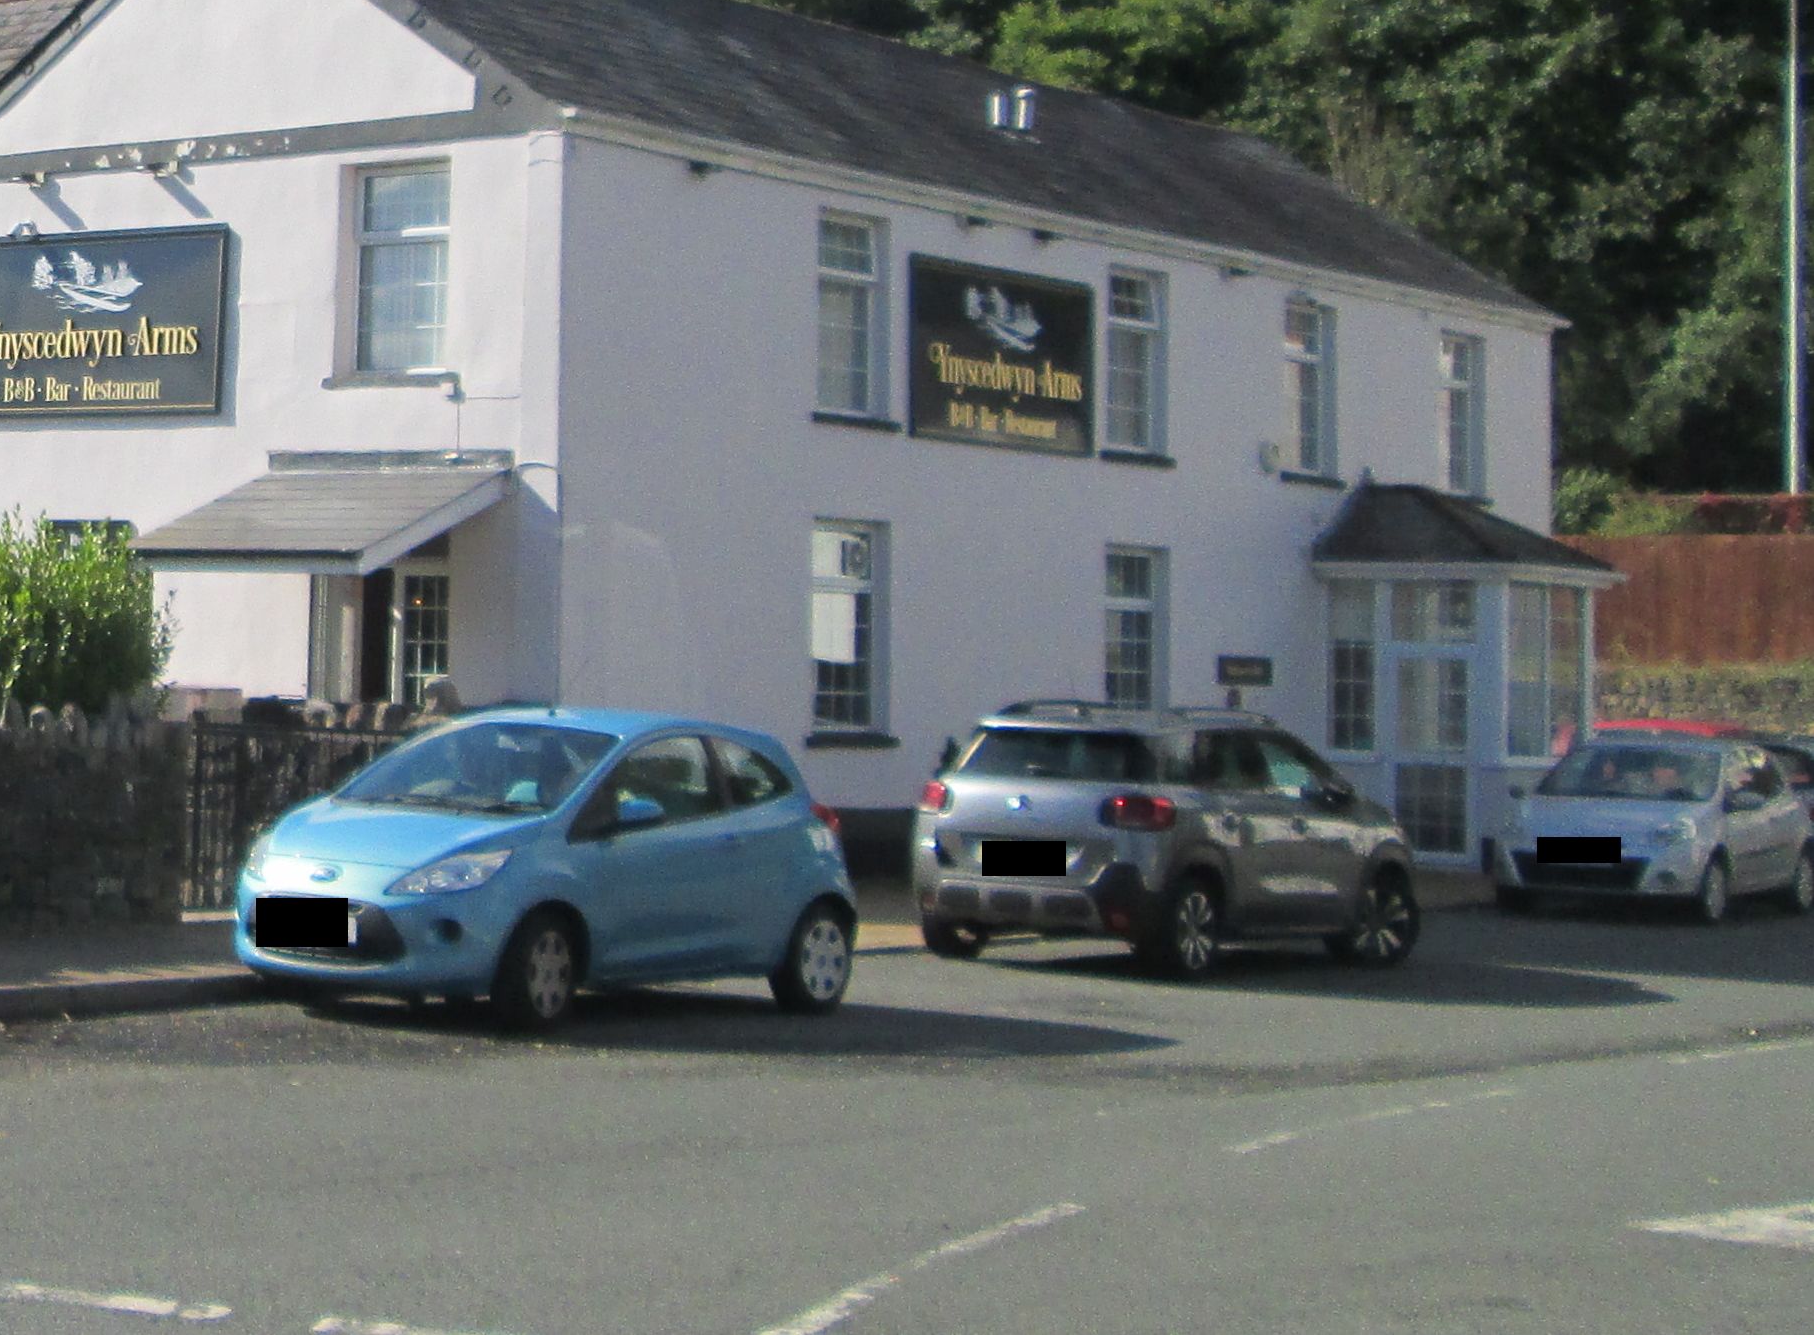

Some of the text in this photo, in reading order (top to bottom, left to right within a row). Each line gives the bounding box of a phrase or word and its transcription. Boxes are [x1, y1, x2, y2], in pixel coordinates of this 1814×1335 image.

[128, 316, 199, 356] Arms
[3, 376, 161, 403] B&B Bar Restaurant
[1039, 360, 1082, 402] Arms
